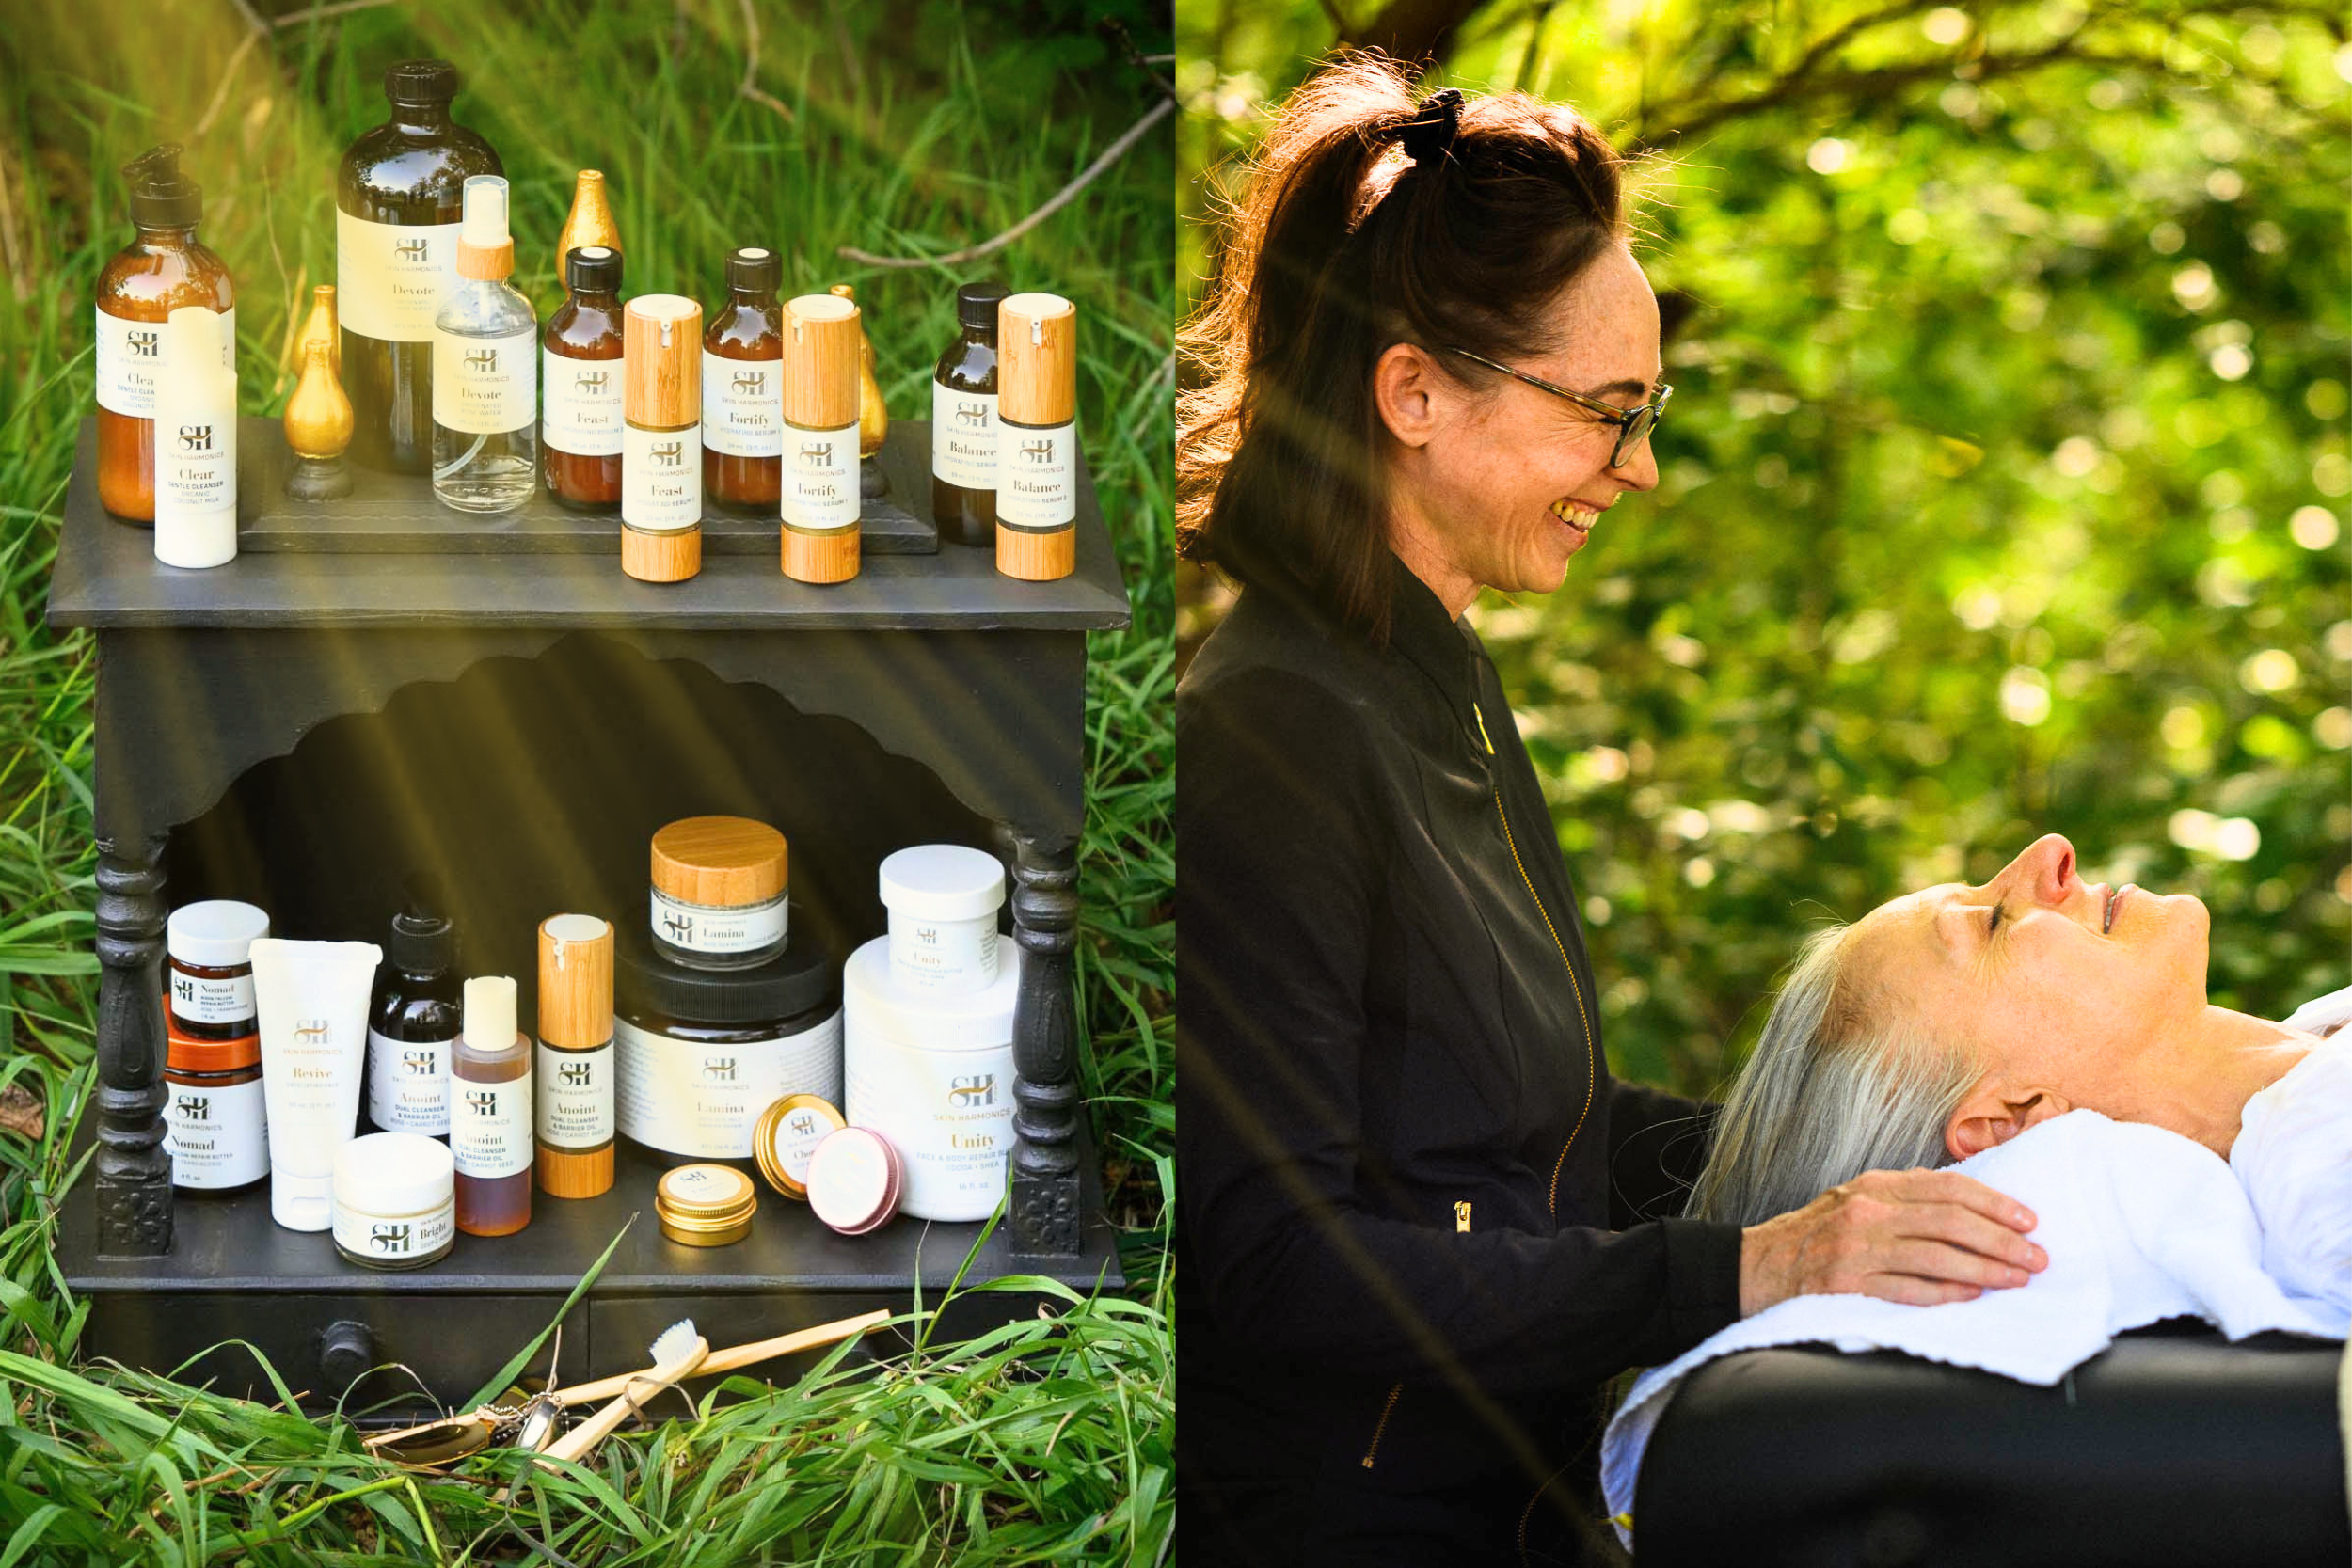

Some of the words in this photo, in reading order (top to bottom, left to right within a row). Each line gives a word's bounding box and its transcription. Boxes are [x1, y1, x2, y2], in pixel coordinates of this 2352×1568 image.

[392, 284, 436, 295] Devote
[126, 330, 158, 356] SH
[127, 372, 154, 386] Clea
[461, 388, 501, 400] Devote
[577, 412, 609, 424] Feast
[729, 411, 771, 428] Fortify
[178, 424, 214, 451] SH
[950, 440, 997, 457] Balance
[179, 468, 215, 480] Clear
[191, 480, 224, 490] CLEANSER
[651, 484, 683, 497] Feast
[798, 483, 836, 499] Fortify
[1013, 479, 1061, 494] Balance
[703, 927, 745, 939] Lamina
[200, 984, 235, 993] Nomad
[402, 1050, 436, 1075] SH
[293, 1066, 333, 1079] Revive
[557, 1061, 591, 1086] SH
[400, 1092, 441, 1103] Anoint
[948, 1073, 995, 1109] SH
[176, 1094, 210, 1119] SH
[411, 1105, 445, 1114] CLEANSER
[556, 1102, 596, 1115] Anoint
[697, 1101, 745, 1114] Lamina
[566, 1115, 599, 1125] CLEANSER
[933, 1113, 955, 1122] SKIN
[958, 1107, 1011, 1122] HARMONICS
[171, 1135, 215, 1150] Nomad
[465, 1132, 503, 1145] Anoint
[951, 1132, 996, 1150] Unity
[472, 1147, 507, 1155] CLEANSER
[420, 1222, 447, 1240] Bright
[370, 1223, 413, 1253] SH
